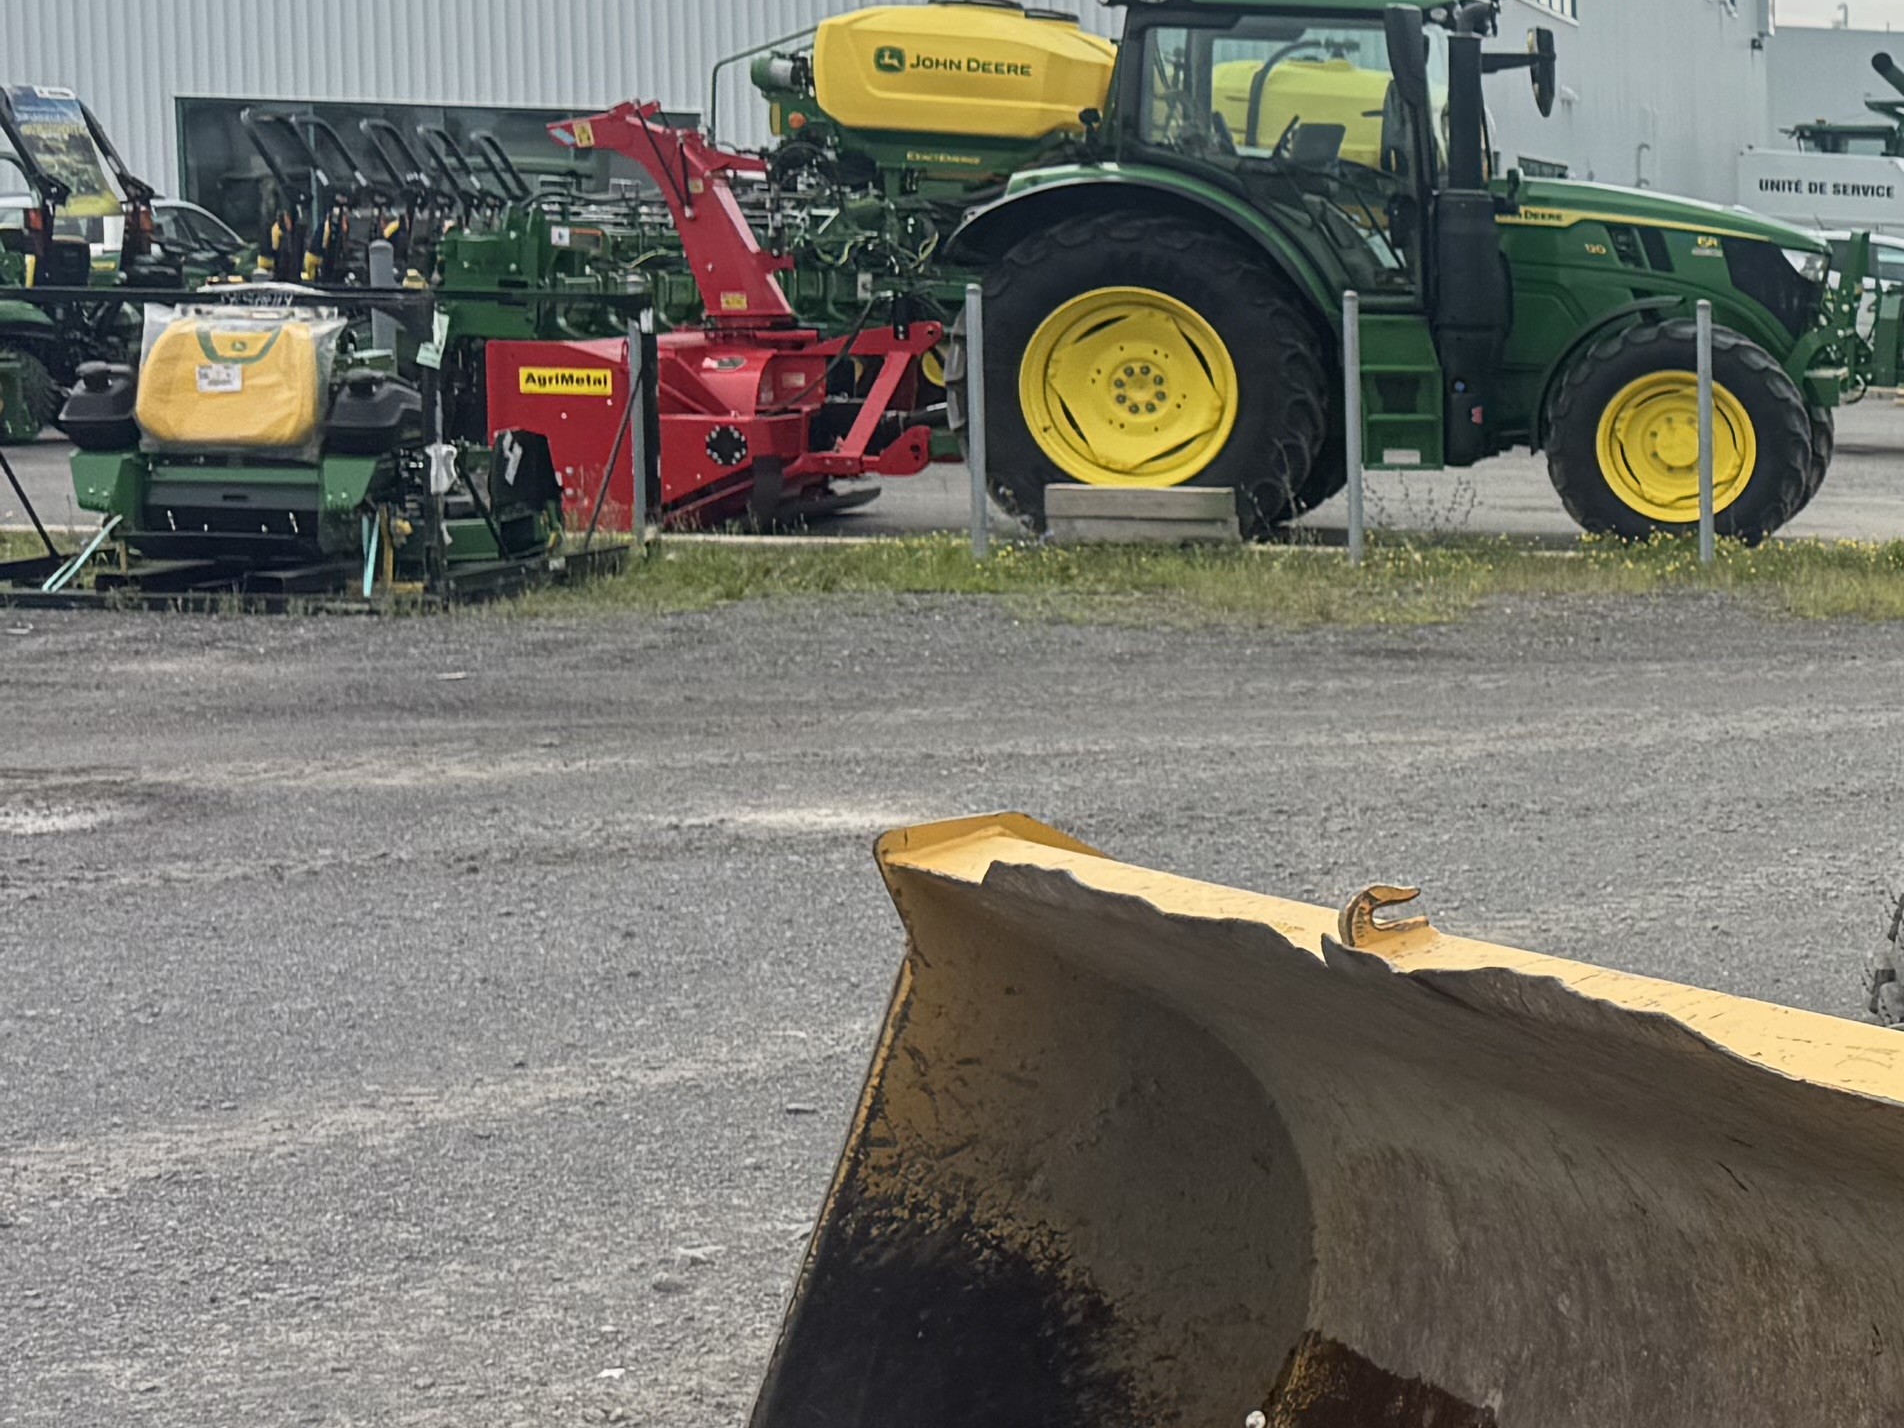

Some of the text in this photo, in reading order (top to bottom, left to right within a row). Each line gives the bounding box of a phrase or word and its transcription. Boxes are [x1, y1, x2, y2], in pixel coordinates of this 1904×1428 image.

[910, 54, 1032, 77] JOHN DEERE
[1759, 178, 1895, 199] UNITÉ DE SERVICE
[525, 373, 608, 389] AgriMetal
